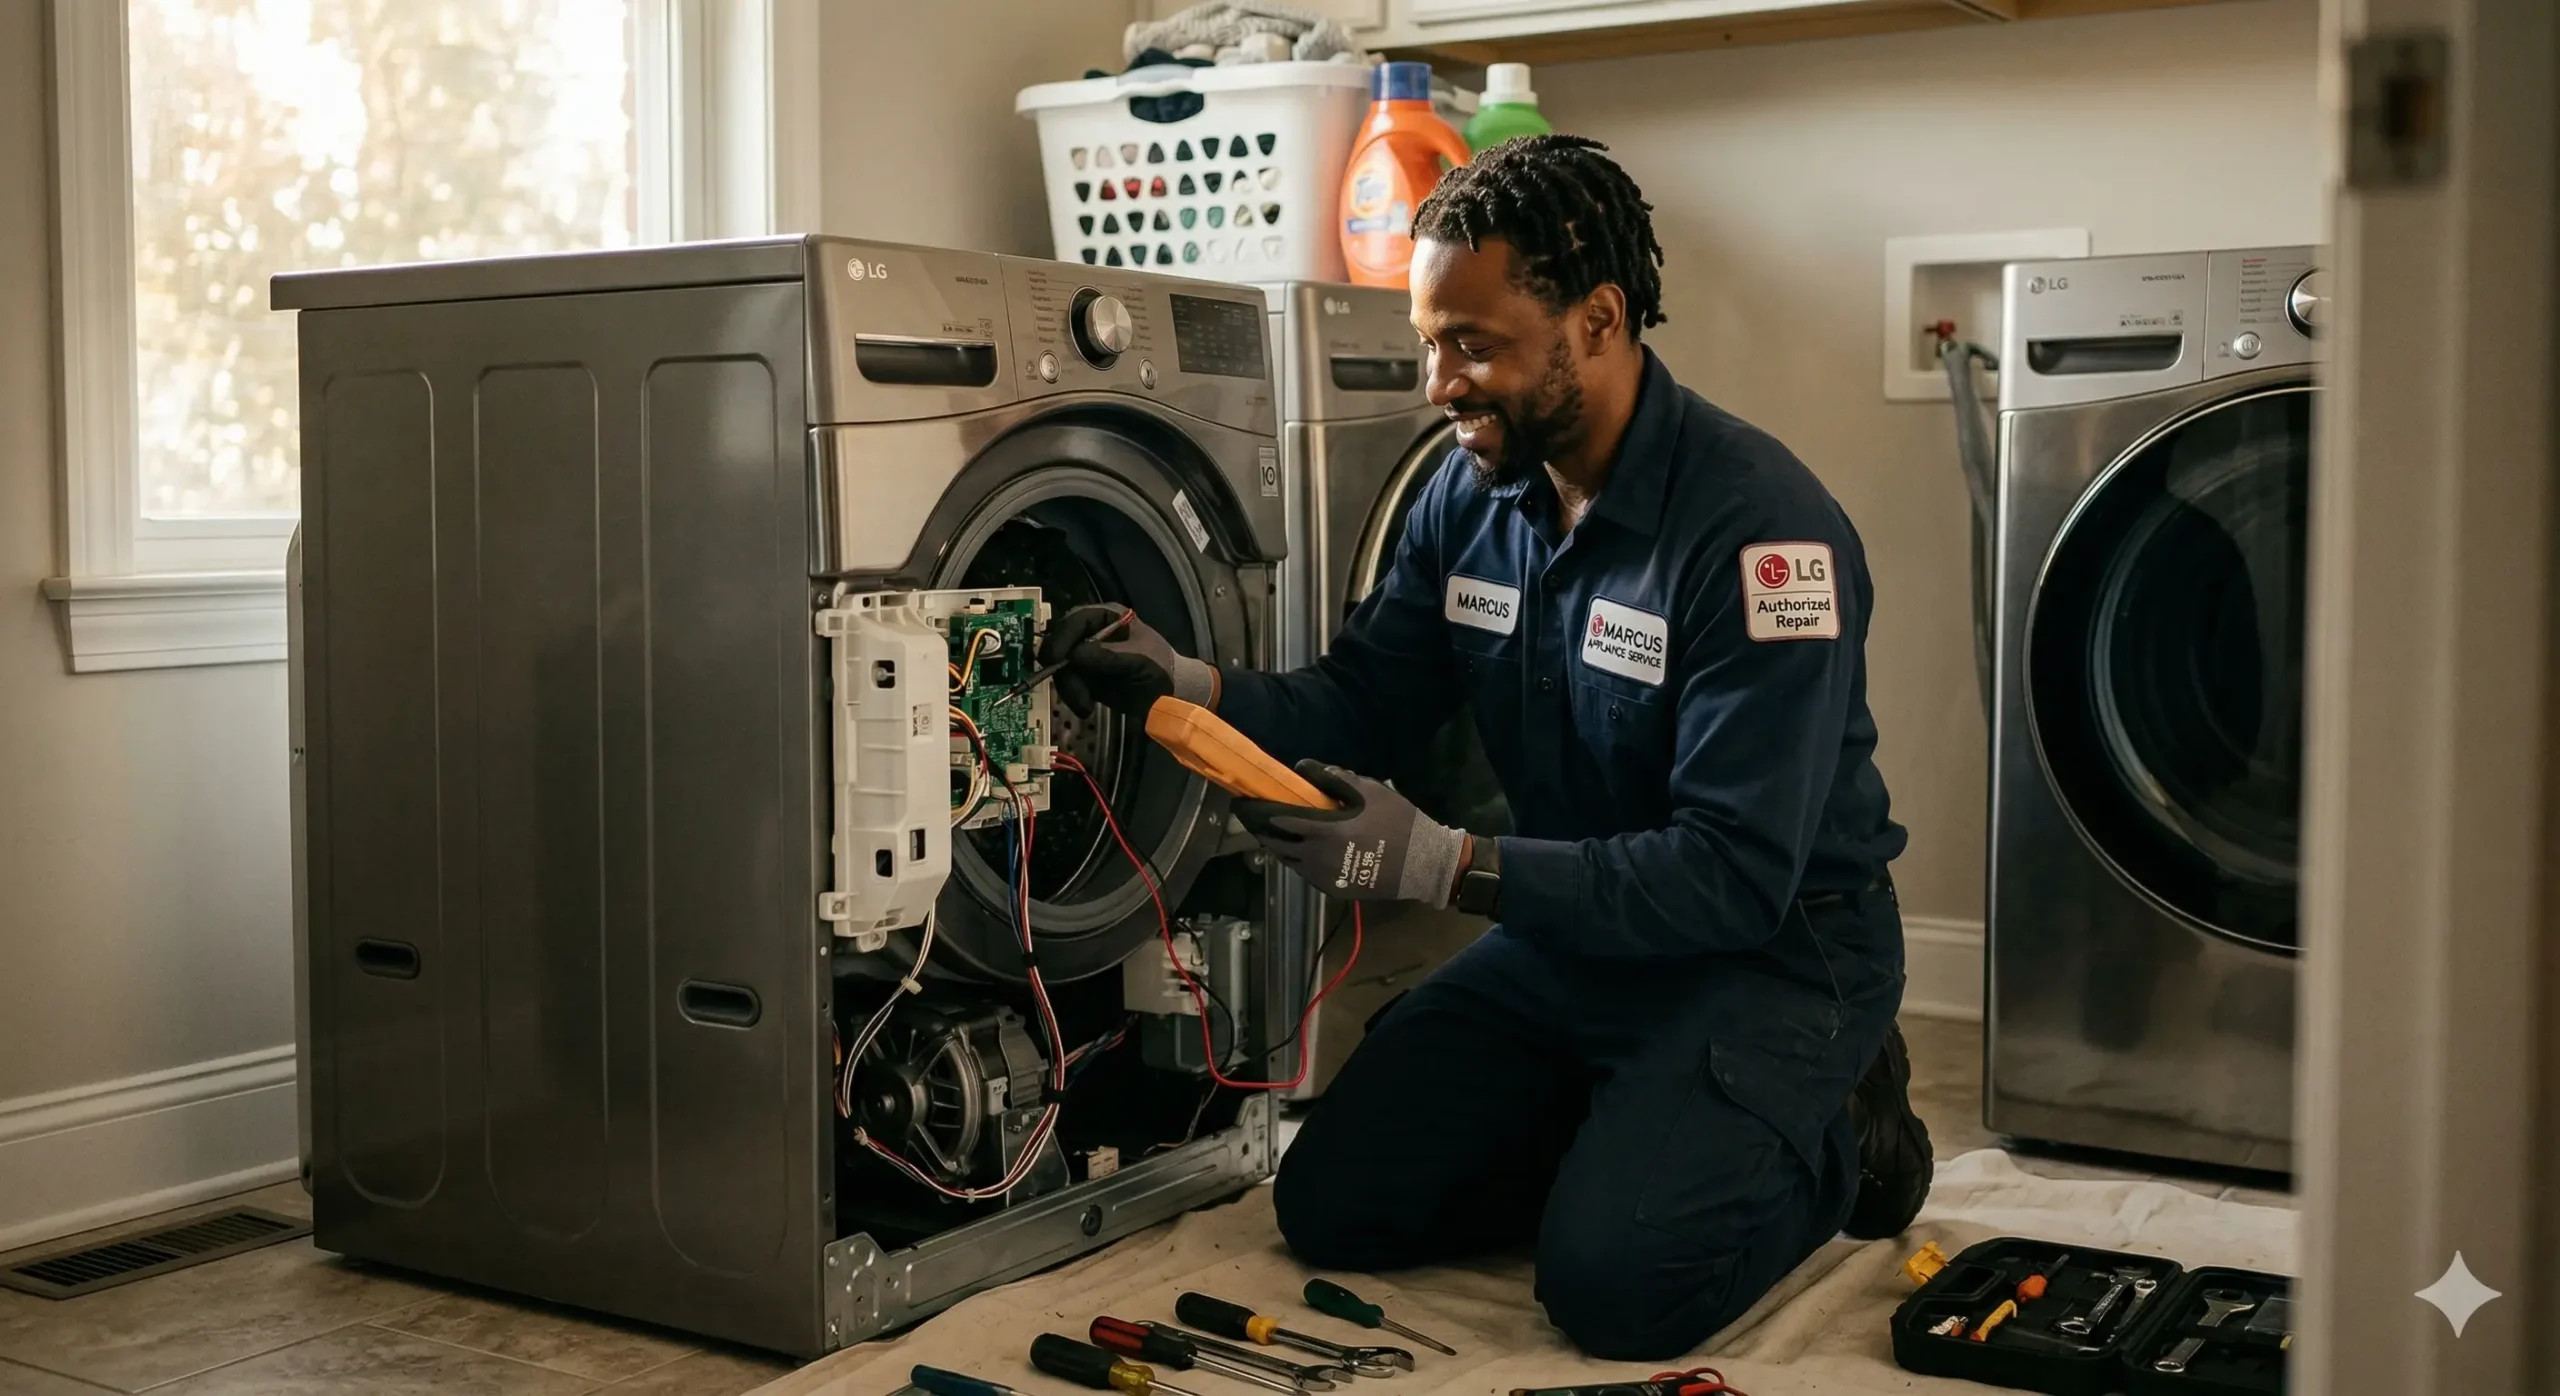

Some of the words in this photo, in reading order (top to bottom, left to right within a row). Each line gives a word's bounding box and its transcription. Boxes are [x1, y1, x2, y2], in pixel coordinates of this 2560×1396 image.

[867, 262, 888, 279] LG
[2049, 277, 2069, 290] LG
[1795, 558, 1825, 582] LG
[1457, 591, 1510, 619] MARCUS
[1756, 597, 1831, 614] Authorized
[1775, 613, 1820, 631] Repair
[1603, 620, 1663, 654] MARCUS
[1627, 649, 1662, 669] SERVICE
